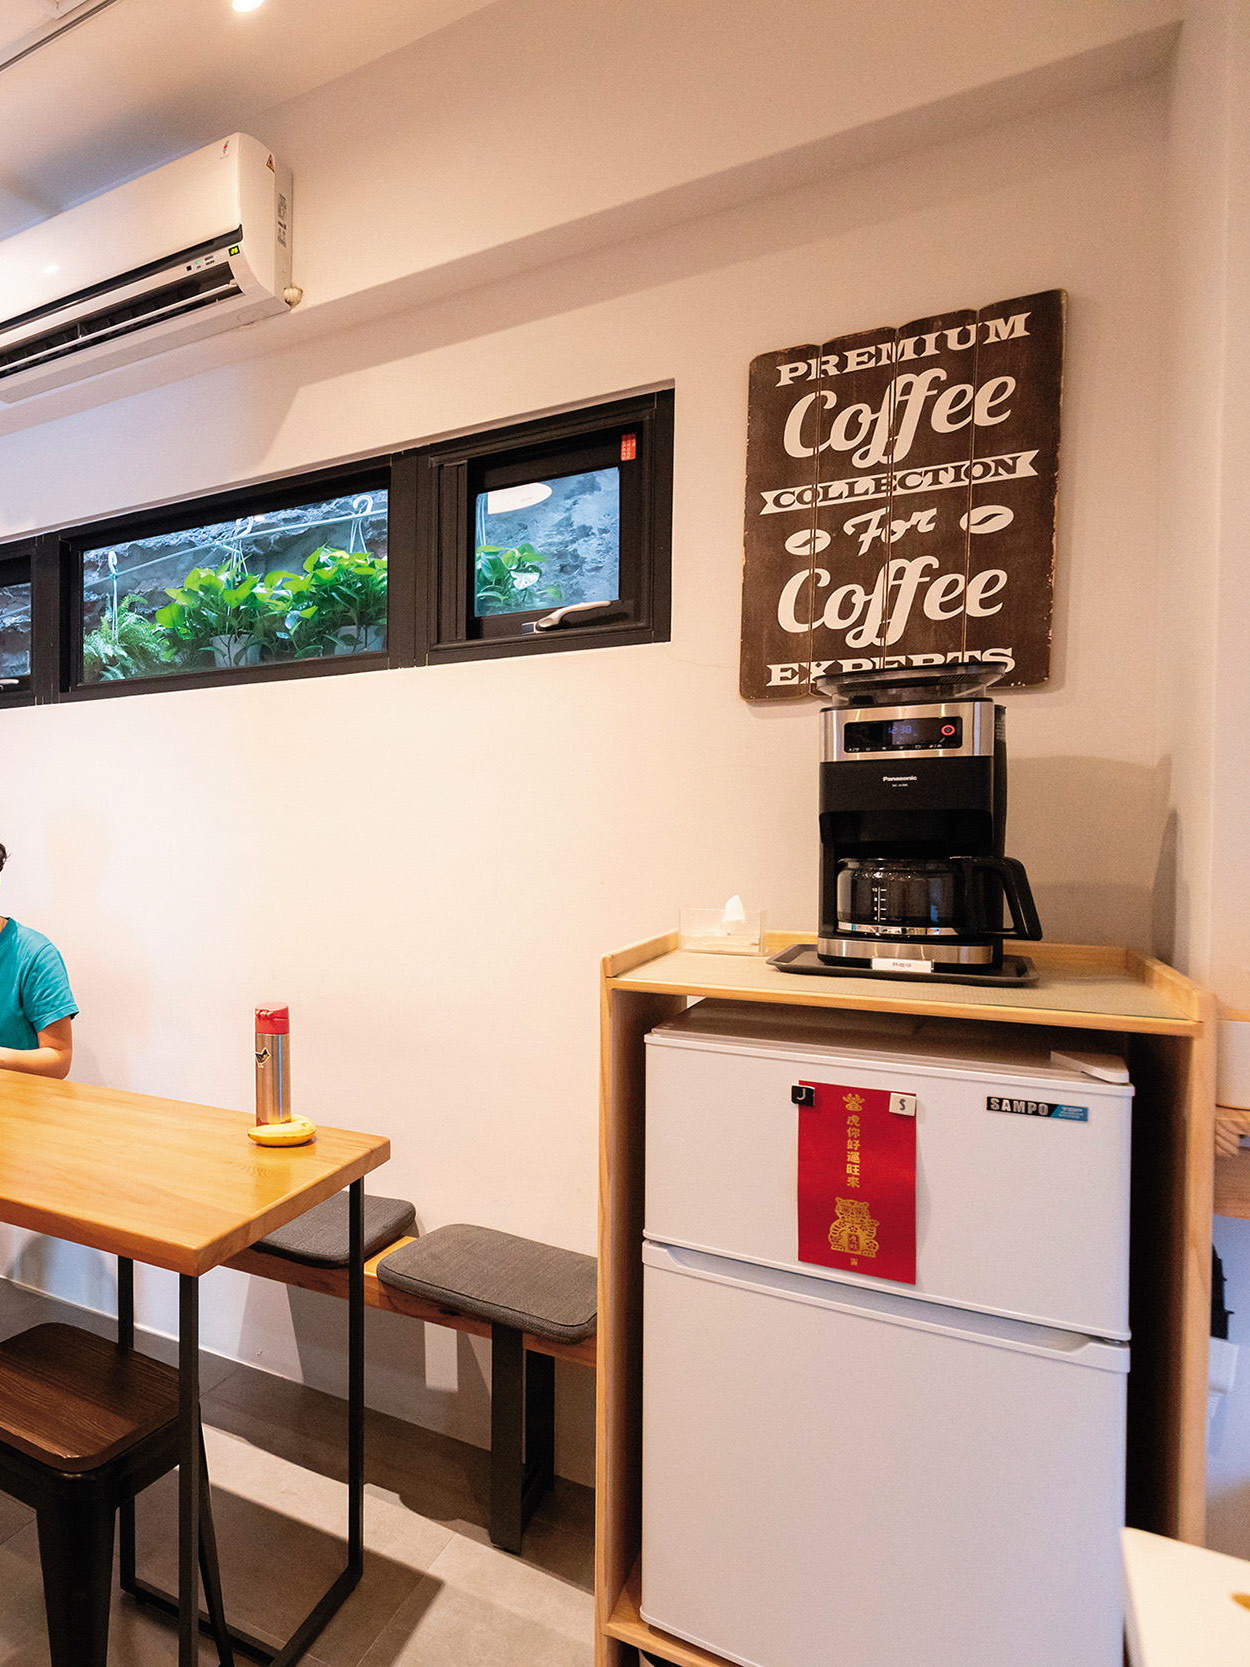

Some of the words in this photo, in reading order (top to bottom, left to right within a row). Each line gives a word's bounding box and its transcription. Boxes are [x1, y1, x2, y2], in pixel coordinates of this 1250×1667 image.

[775, 312, 1031, 387] PREMIUM
[783, 368, 1016, 469] Coffee
[772, 455, 1023, 509] COLLECTION
[843, 506, 937, 556] For
[777, 555, 1008, 648] Coffee
[796, 1088, 806, 1100] J
[899, 1098, 906, 1111] S
[990, 1097, 1049, 1116] SAMPO
